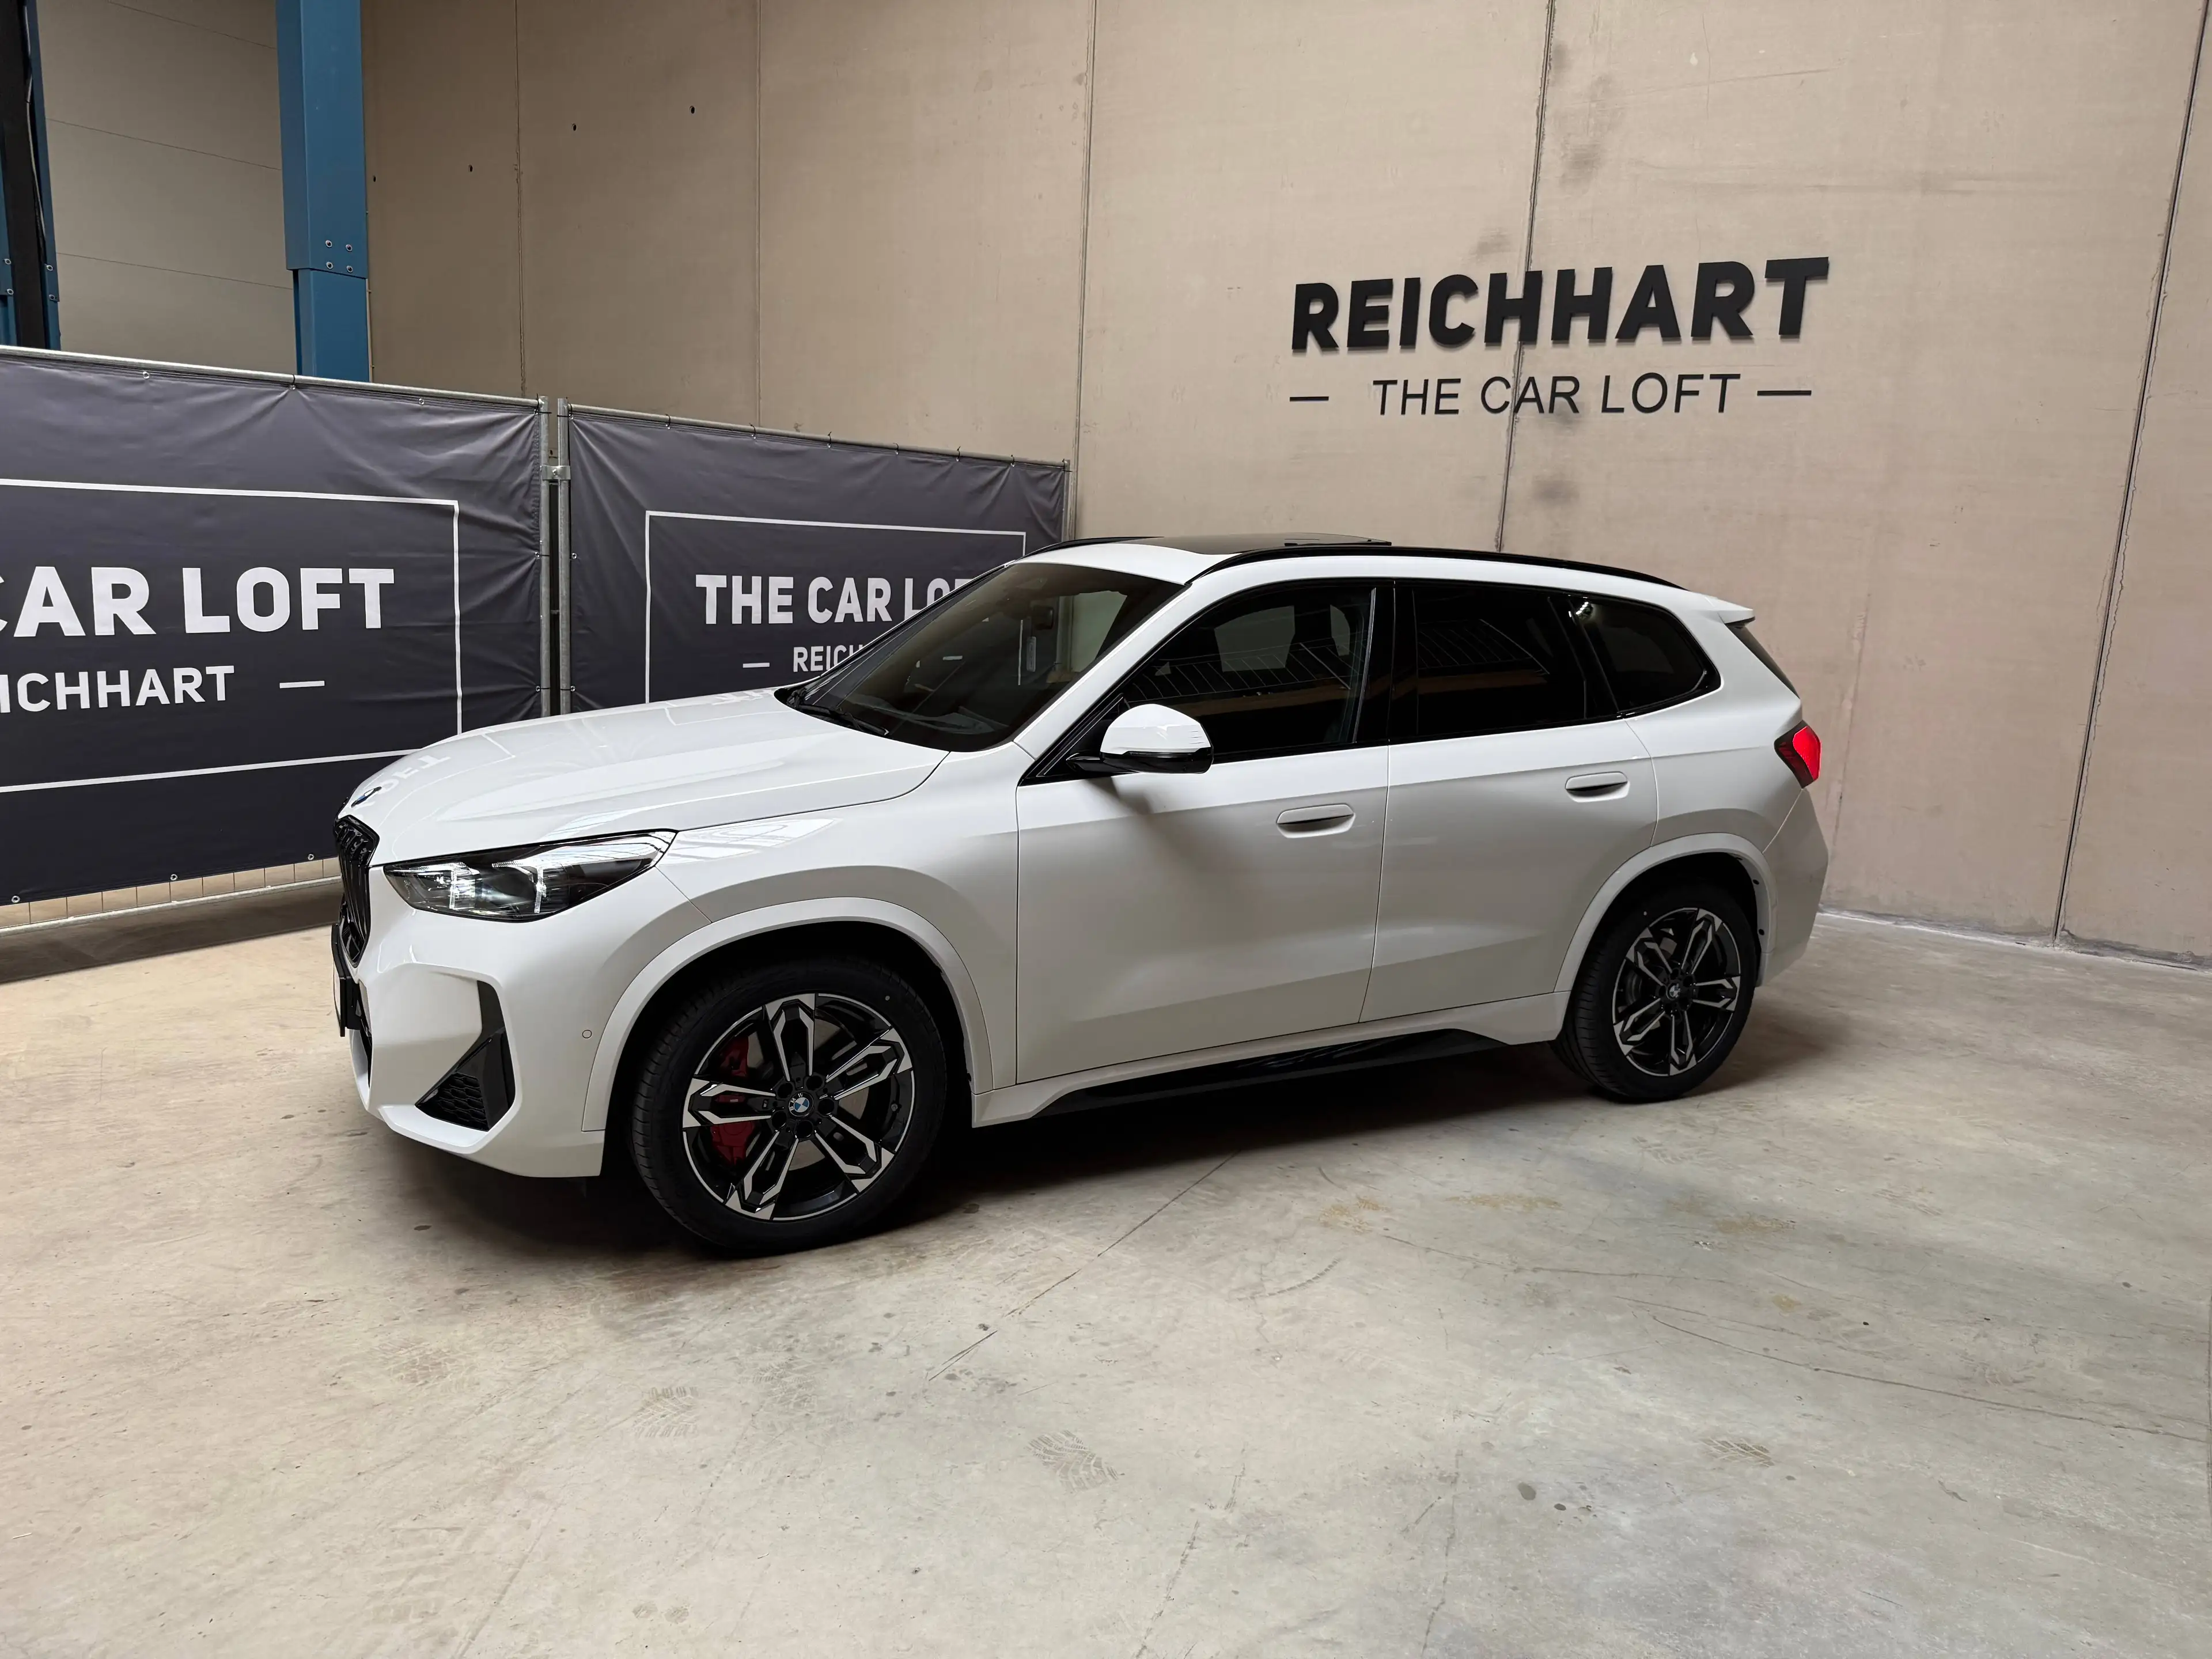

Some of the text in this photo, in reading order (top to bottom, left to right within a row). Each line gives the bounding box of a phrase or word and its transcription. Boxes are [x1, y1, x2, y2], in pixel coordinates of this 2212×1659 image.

[1291, 256, 1830, 353] REICHHART
[1373, 372, 1741, 415] THE CAR LOFT
[0, 566, 395, 637] AR LOFT
[695, 574, 974, 624] THE CAR LO
